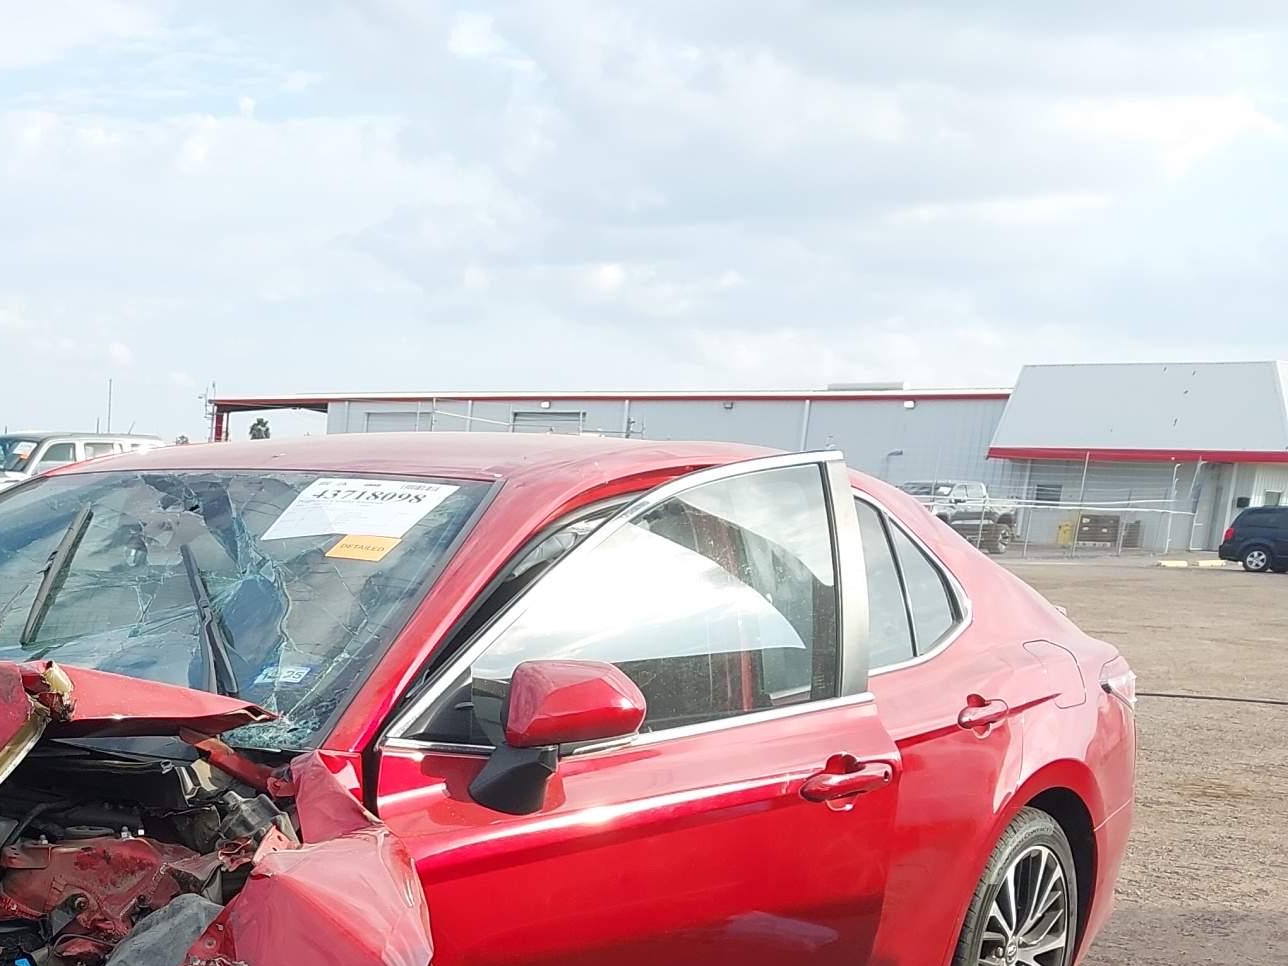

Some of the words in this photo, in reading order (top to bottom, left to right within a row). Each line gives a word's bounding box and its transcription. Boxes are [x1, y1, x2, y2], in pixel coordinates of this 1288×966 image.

[312, 488, 427, 504] 43718098
[339, 543, 385, 552] DETAILED
[283, 670, 303, 680] 25
